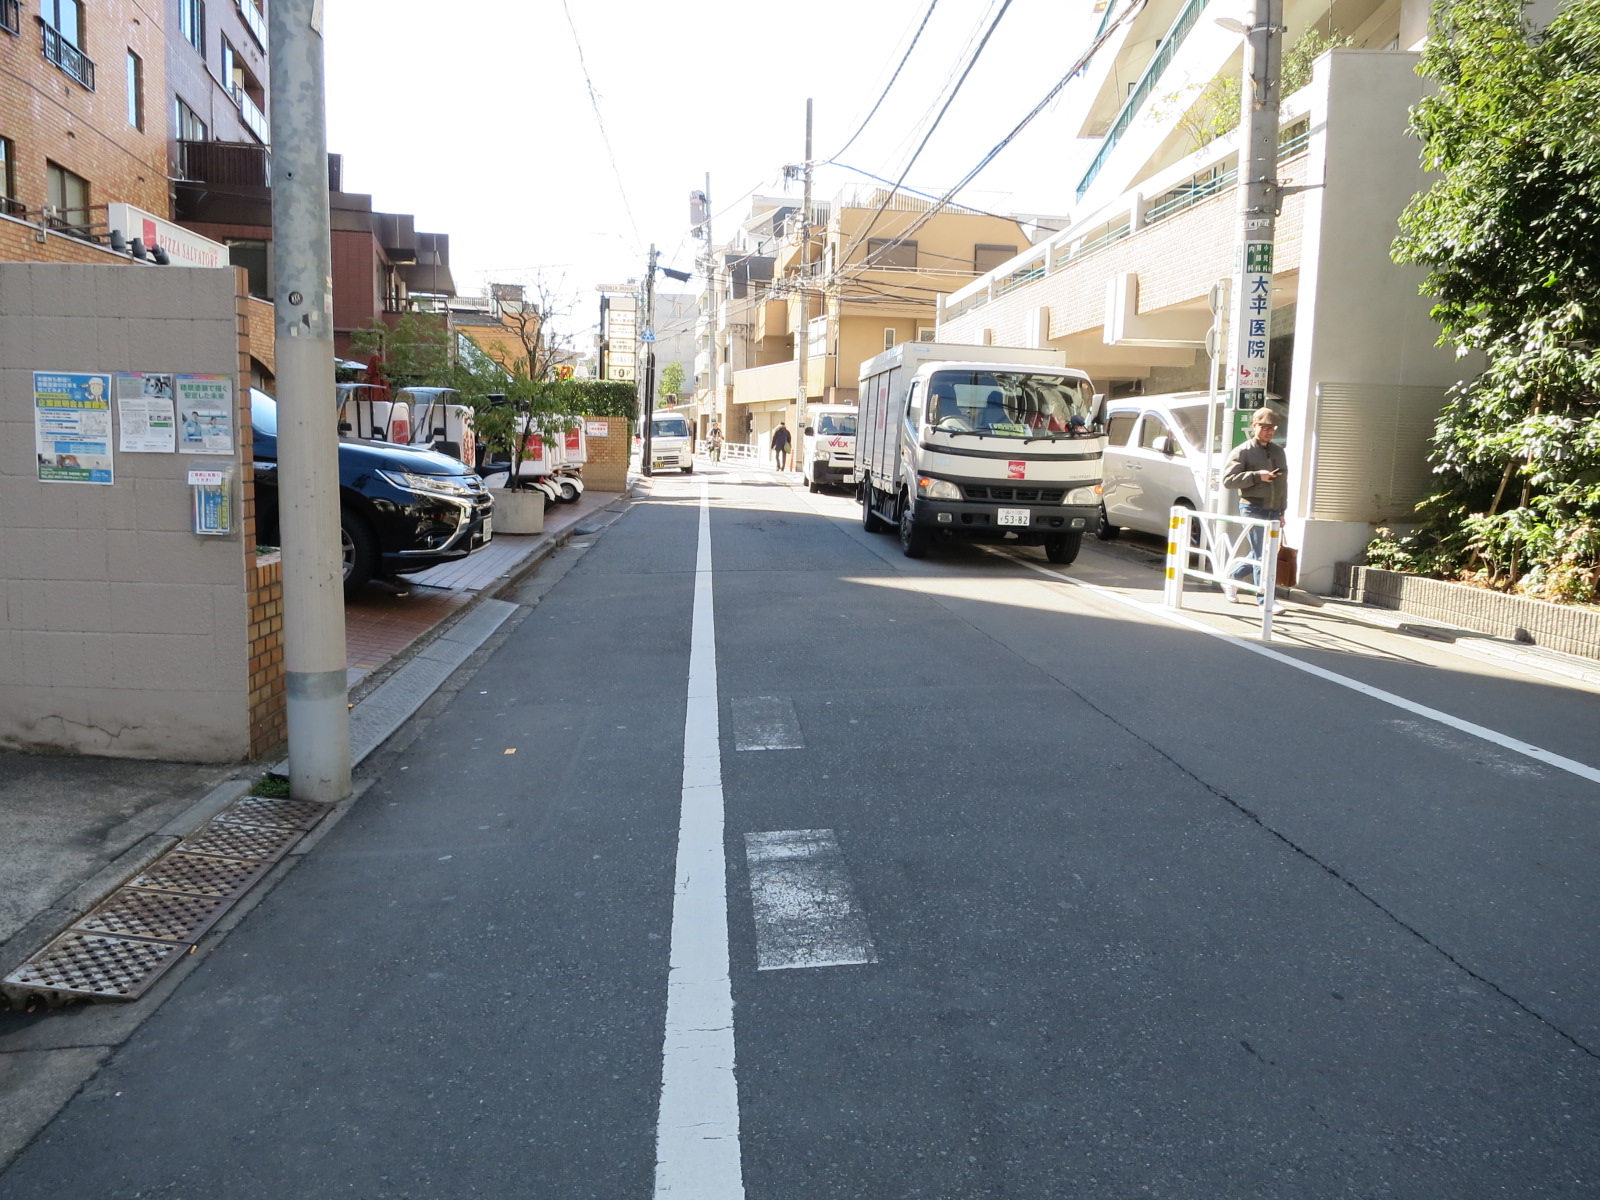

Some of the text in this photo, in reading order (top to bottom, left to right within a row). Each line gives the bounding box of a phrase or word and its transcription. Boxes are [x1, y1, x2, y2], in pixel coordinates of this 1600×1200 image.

[160, 234, 180, 256] PIZZA
[1247, 275, 1268, 359] 大平医院
[184, 391, 225, 400] 安定した未来
[1004, 515, 1028, 524] 53-82
